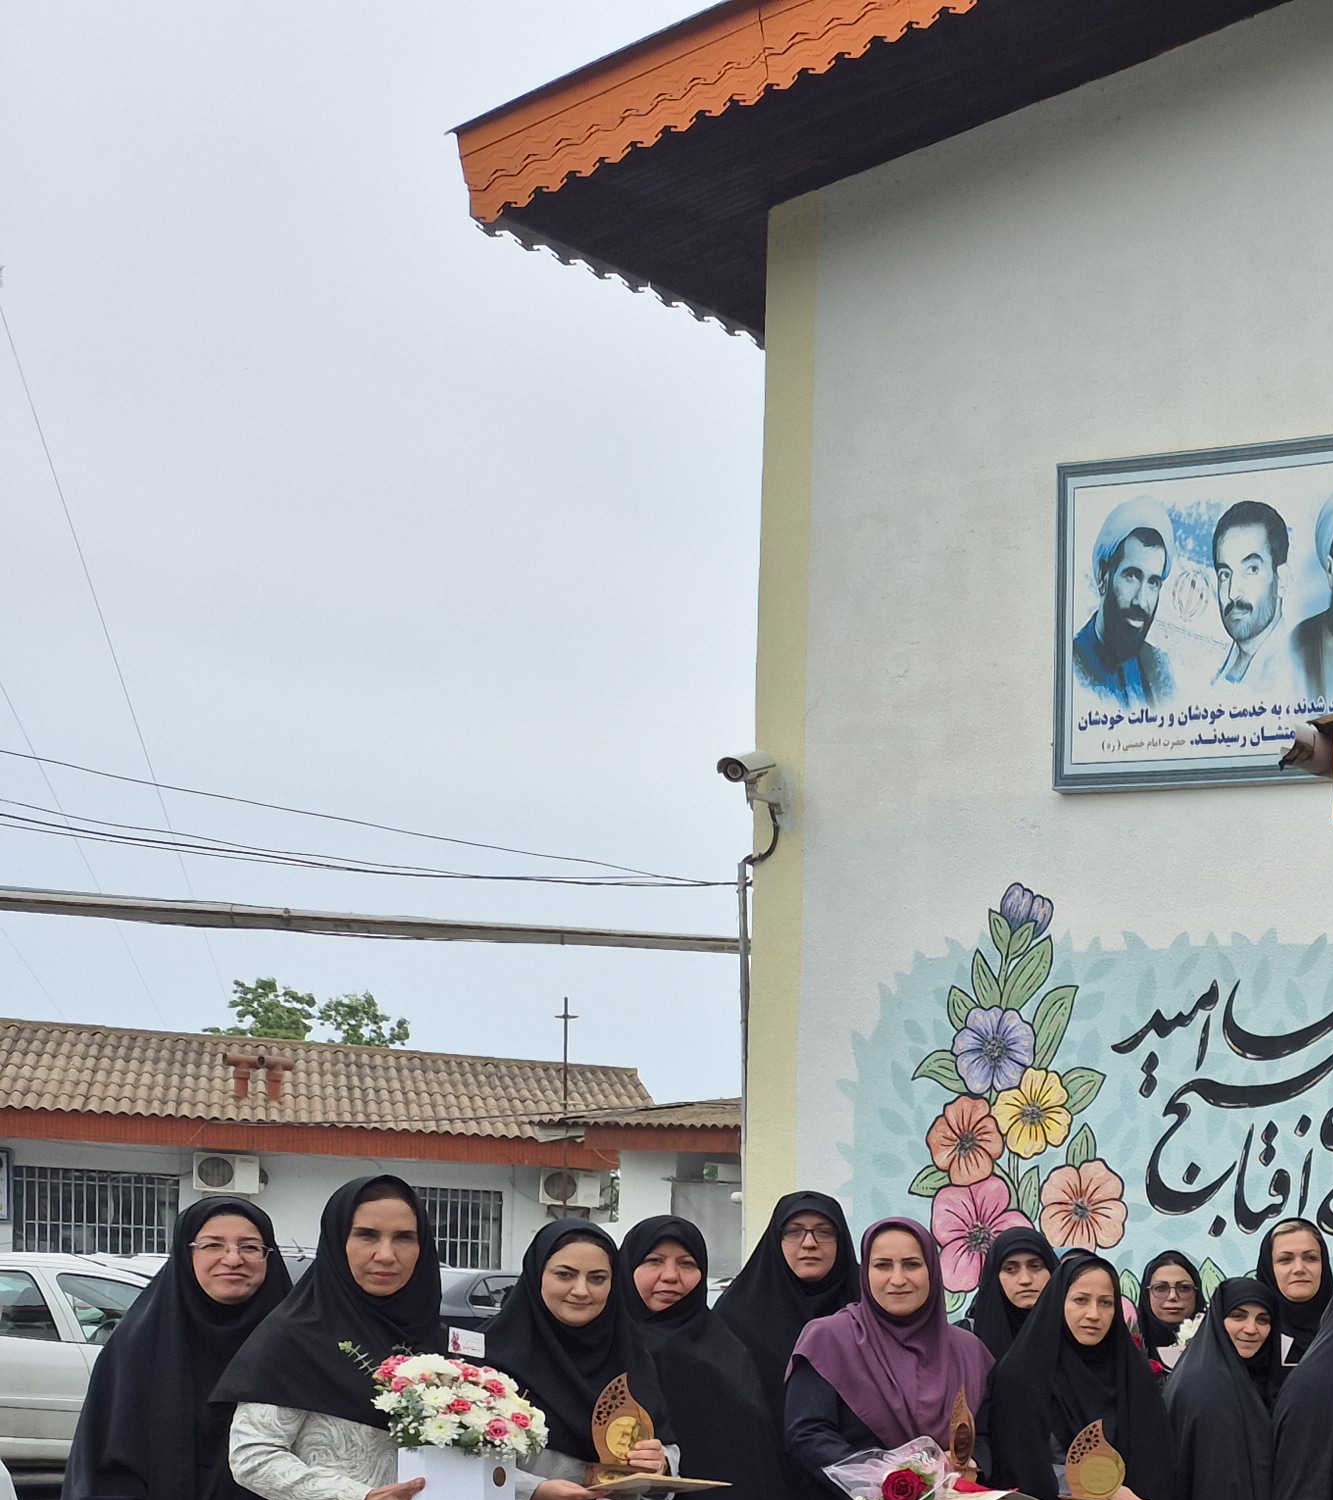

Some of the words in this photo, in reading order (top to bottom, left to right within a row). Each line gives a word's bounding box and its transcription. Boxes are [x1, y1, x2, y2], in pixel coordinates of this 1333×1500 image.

[1178, 703, 1225, 725] خودشان
[1229, 701, 1267, 719] خدمت
[1271, 703, 1282, 719] به
[1293, 697, 1325, 715] شدند
[1078, 709, 1125, 731] خودشان
[1128, 708, 1164, 728] رسالت
[1167, 712, 1175, 727] و
[1146, 738, 1161, 751] امام
[1162, 736, 1186, 750] حضرت
[1250, 724, 1296, 747] متشان
[1122, 739, 1145, 752] خمینی
